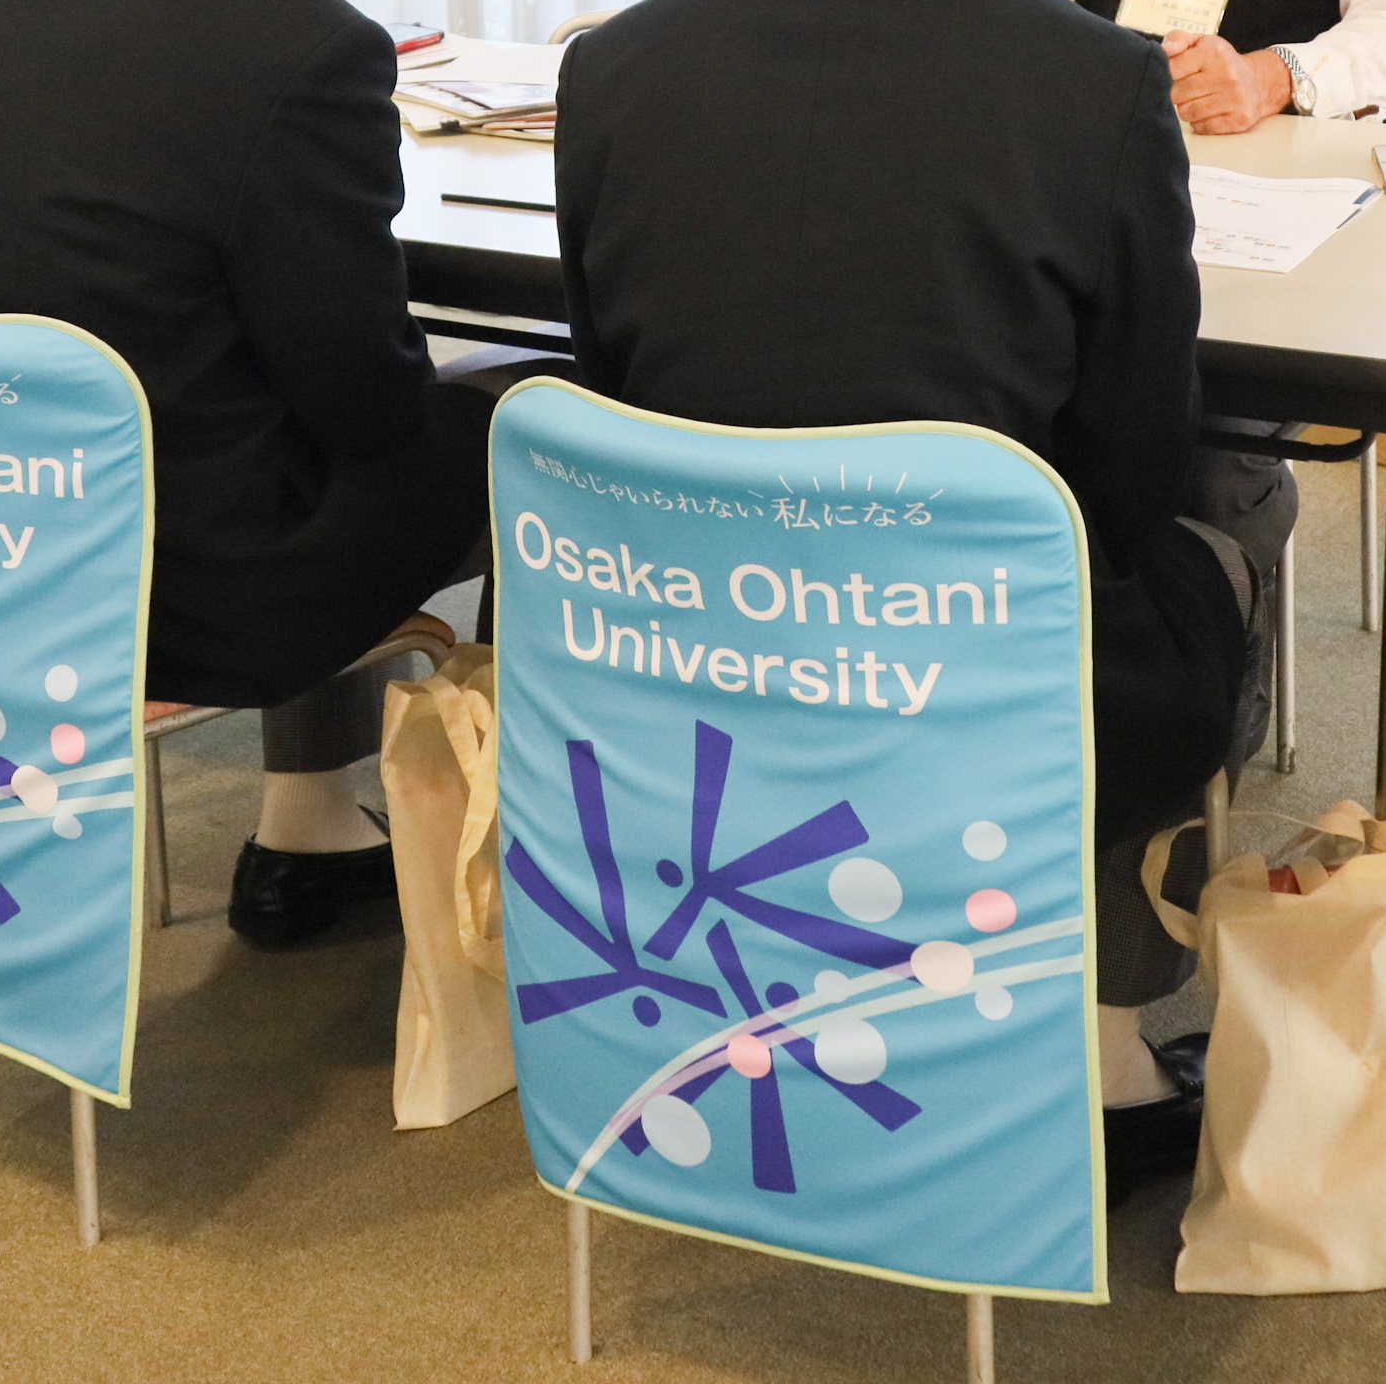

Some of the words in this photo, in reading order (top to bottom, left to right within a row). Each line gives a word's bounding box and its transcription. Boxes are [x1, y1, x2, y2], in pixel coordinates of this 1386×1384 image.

[514, 511, 706, 610] Osaka
[728, 564, 1009, 627] Ohtani
[561, 598, 943, 715] University
